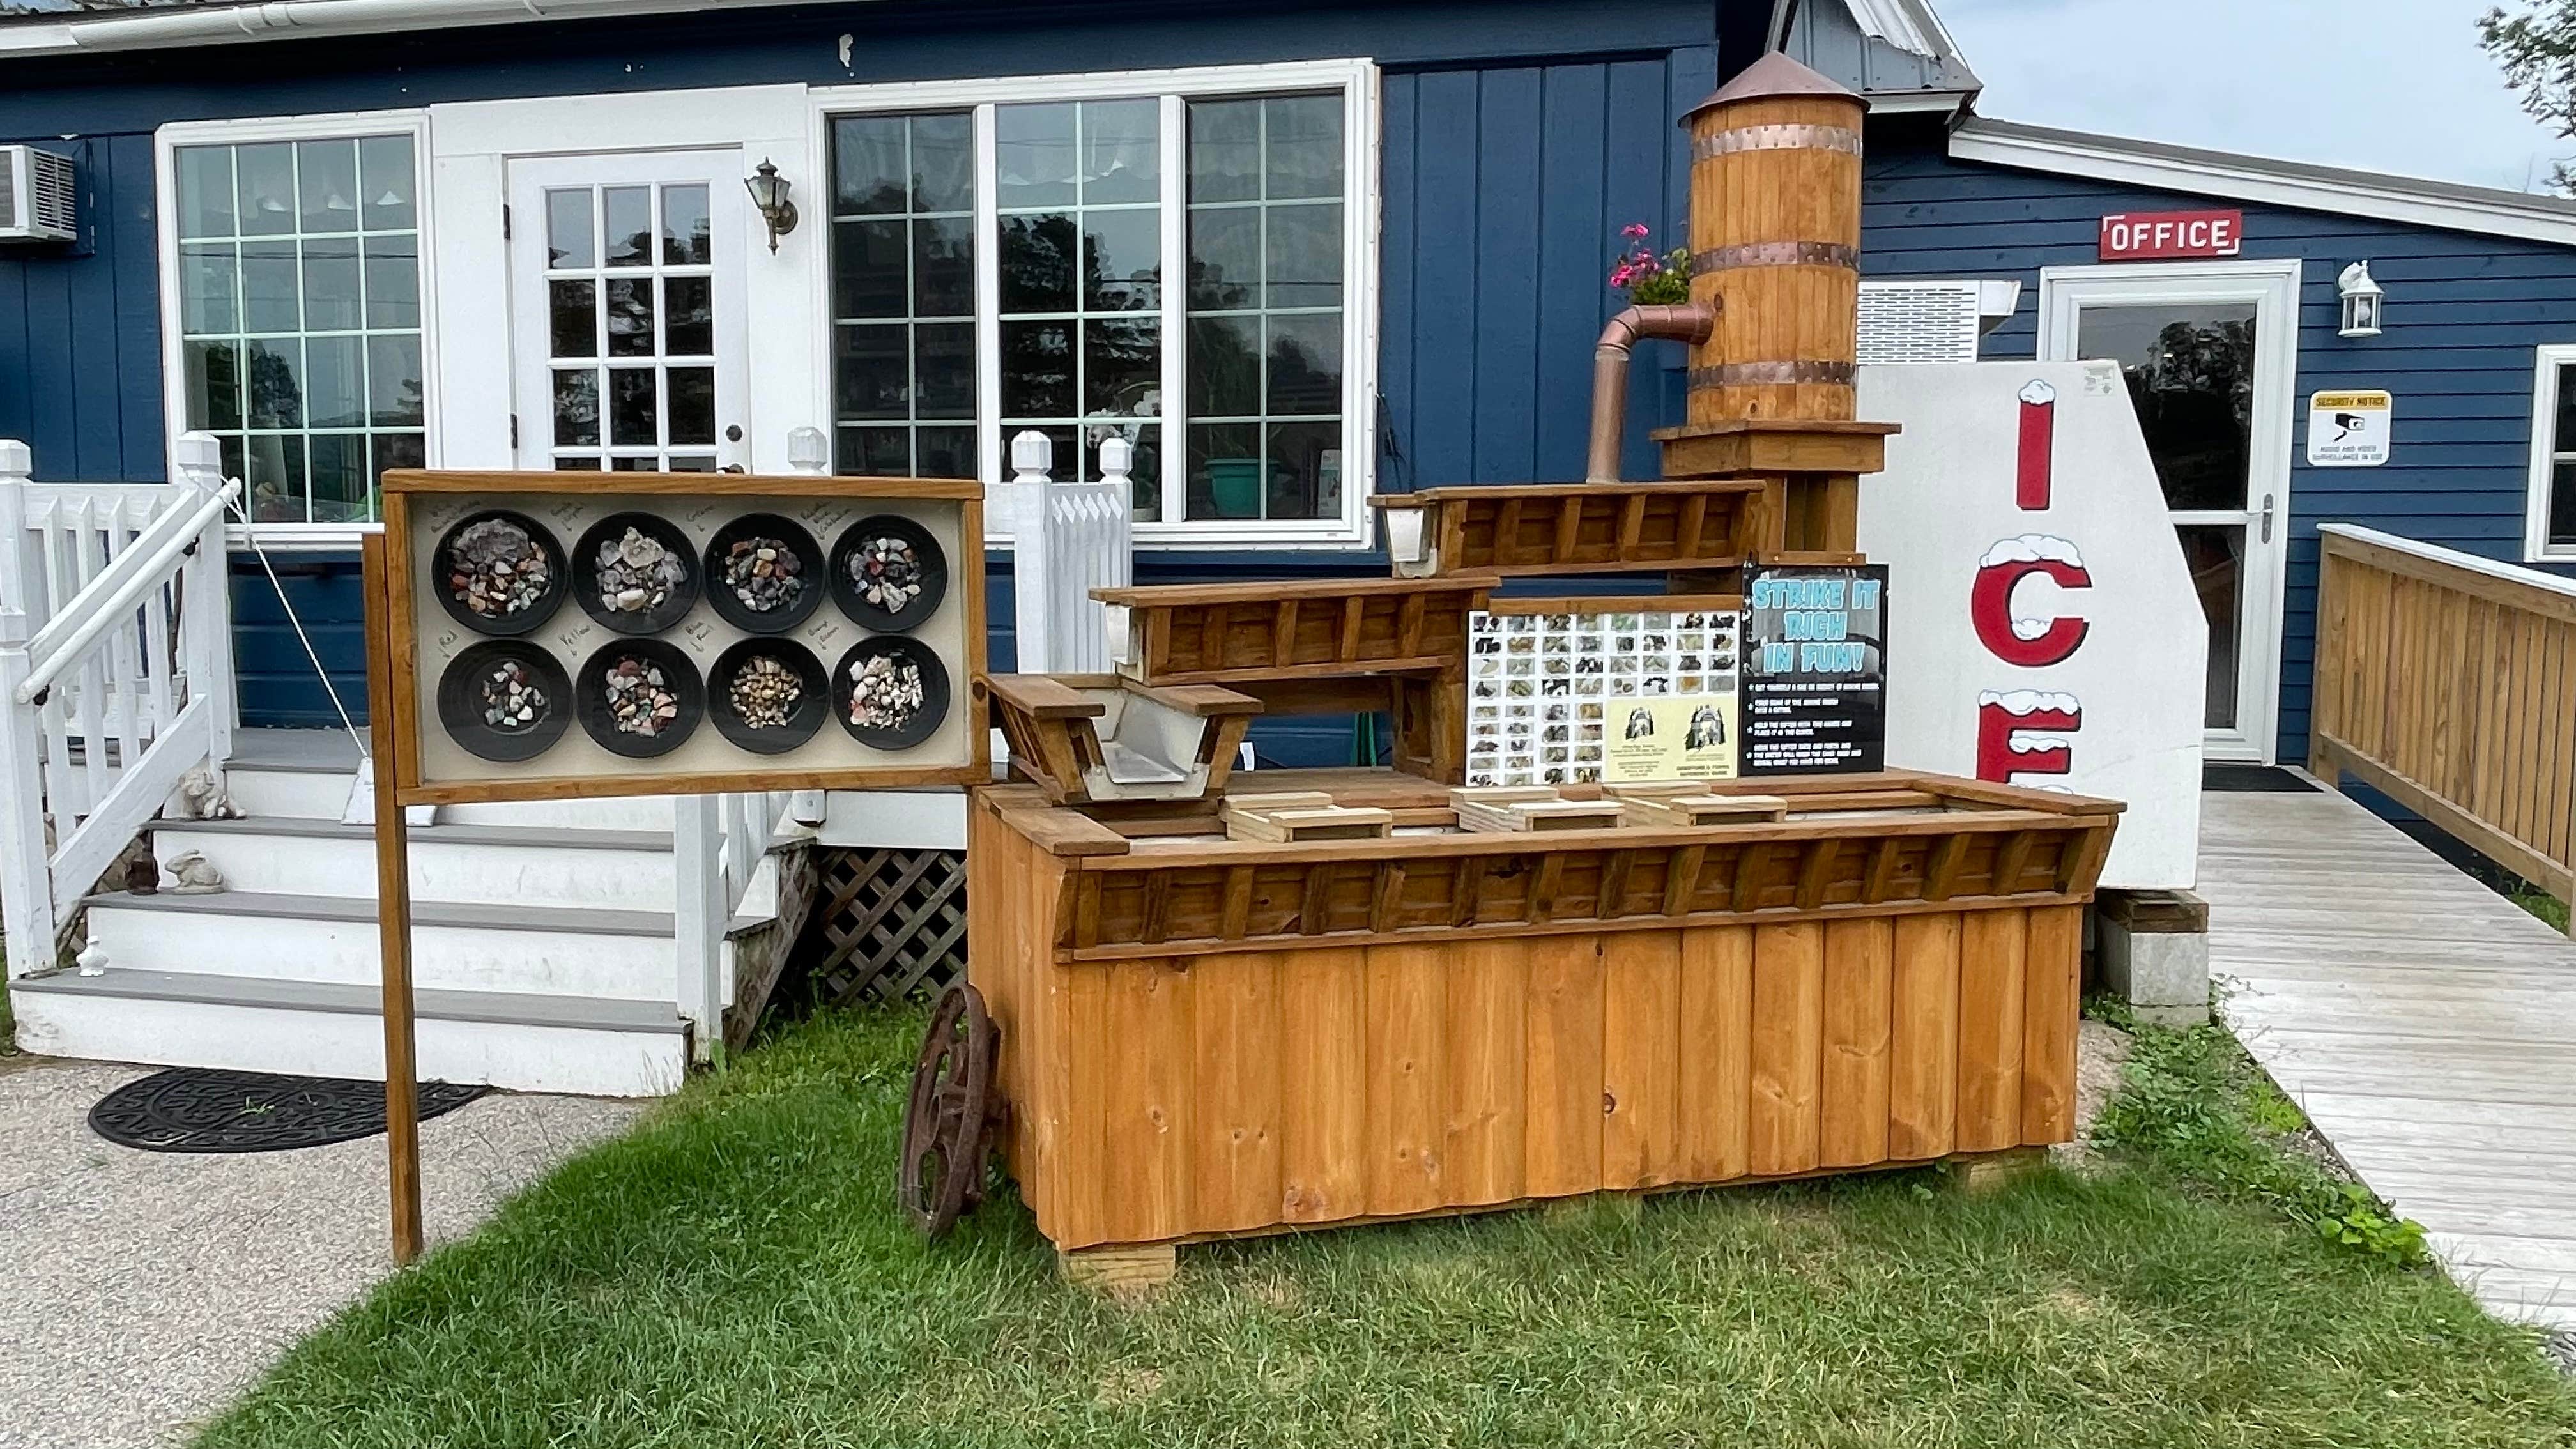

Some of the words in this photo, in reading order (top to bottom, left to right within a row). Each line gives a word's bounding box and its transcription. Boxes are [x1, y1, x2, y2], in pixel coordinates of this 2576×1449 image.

[2111, 220, 2230, 250] OFFICE
[1752, 579, 1846, 610] STRIKE
[1852, 580, 1882, 610] IT
[1784, 611, 1848, 641] RICH
[1763, 643, 1794, 672] IN
[1800, 643, 1866, 672] FUN!
